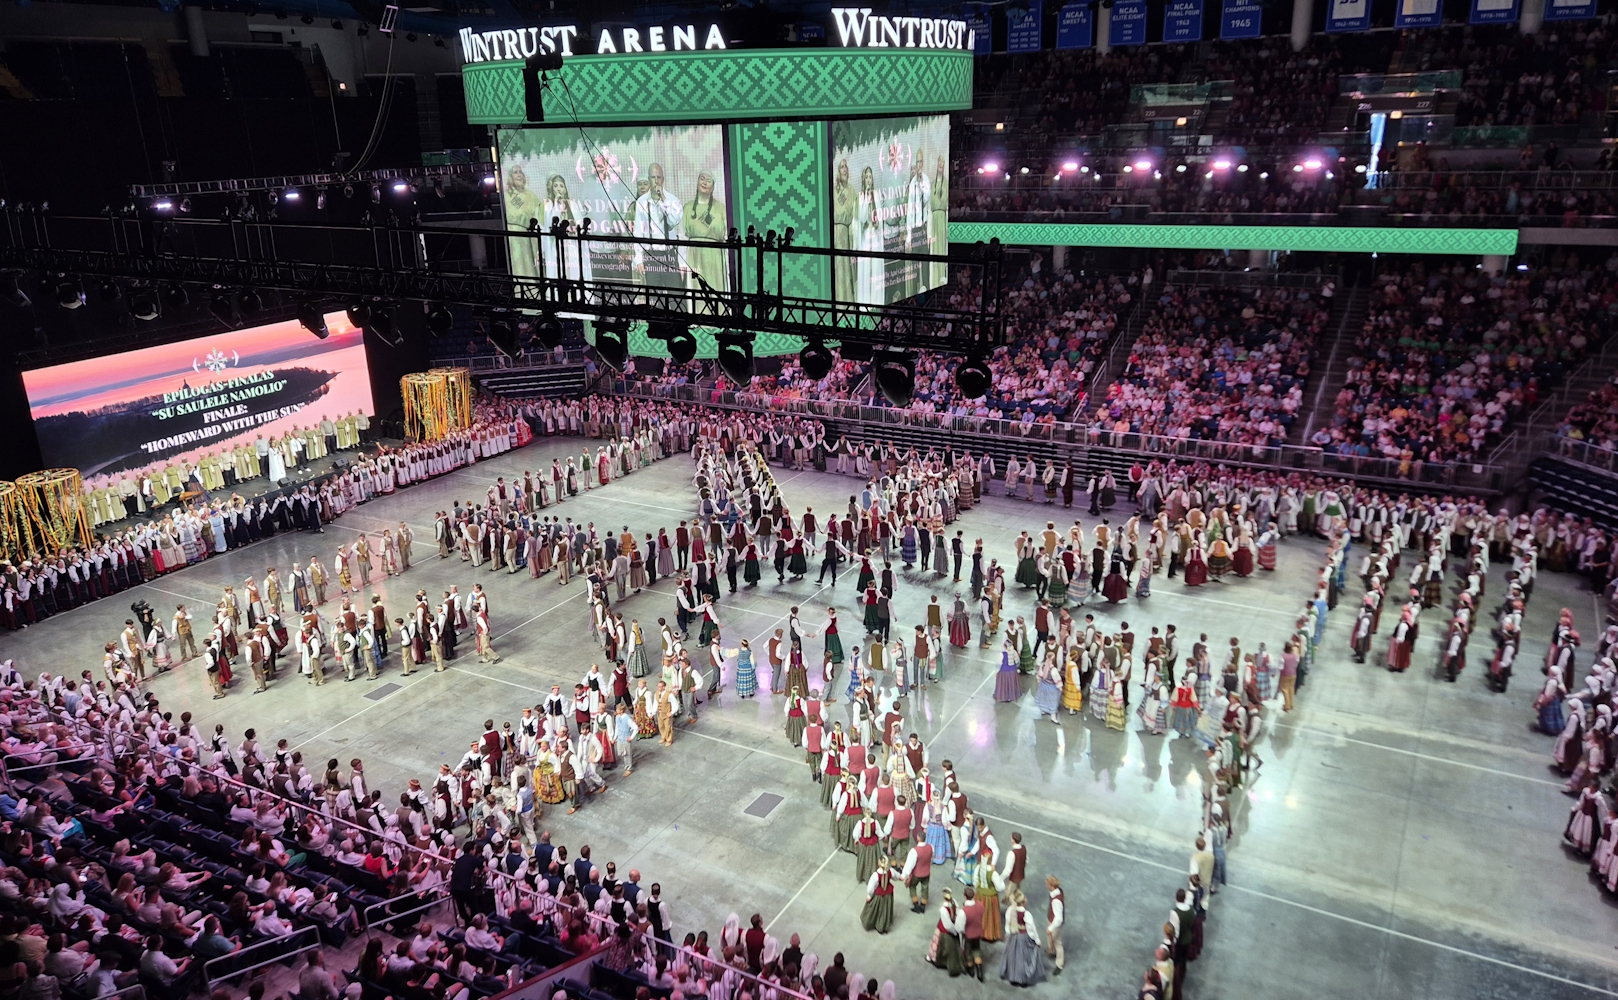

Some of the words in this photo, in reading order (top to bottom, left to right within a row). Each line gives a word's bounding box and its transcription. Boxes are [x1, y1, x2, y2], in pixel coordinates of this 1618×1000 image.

[1225, 5, 1260, 13] CHAMPIONS
[831, 8, 966, 49] WINTRUST
[1231, 19, 1251, 28] 1945
[459, 25, 577, 63] WINTRUST
[598, 24, 726, 53] ARENA
[872, 207, 889, 222] GOD
[566, 219, 598, 234] GD
[588, 261, 630, 272] horeography
[177, 393, 229, 416] SAULELE
[203, 404, 248, 424] FINALE:
[221, 416, 255, 433] WITH
[255, 409, 279, 424] THE
